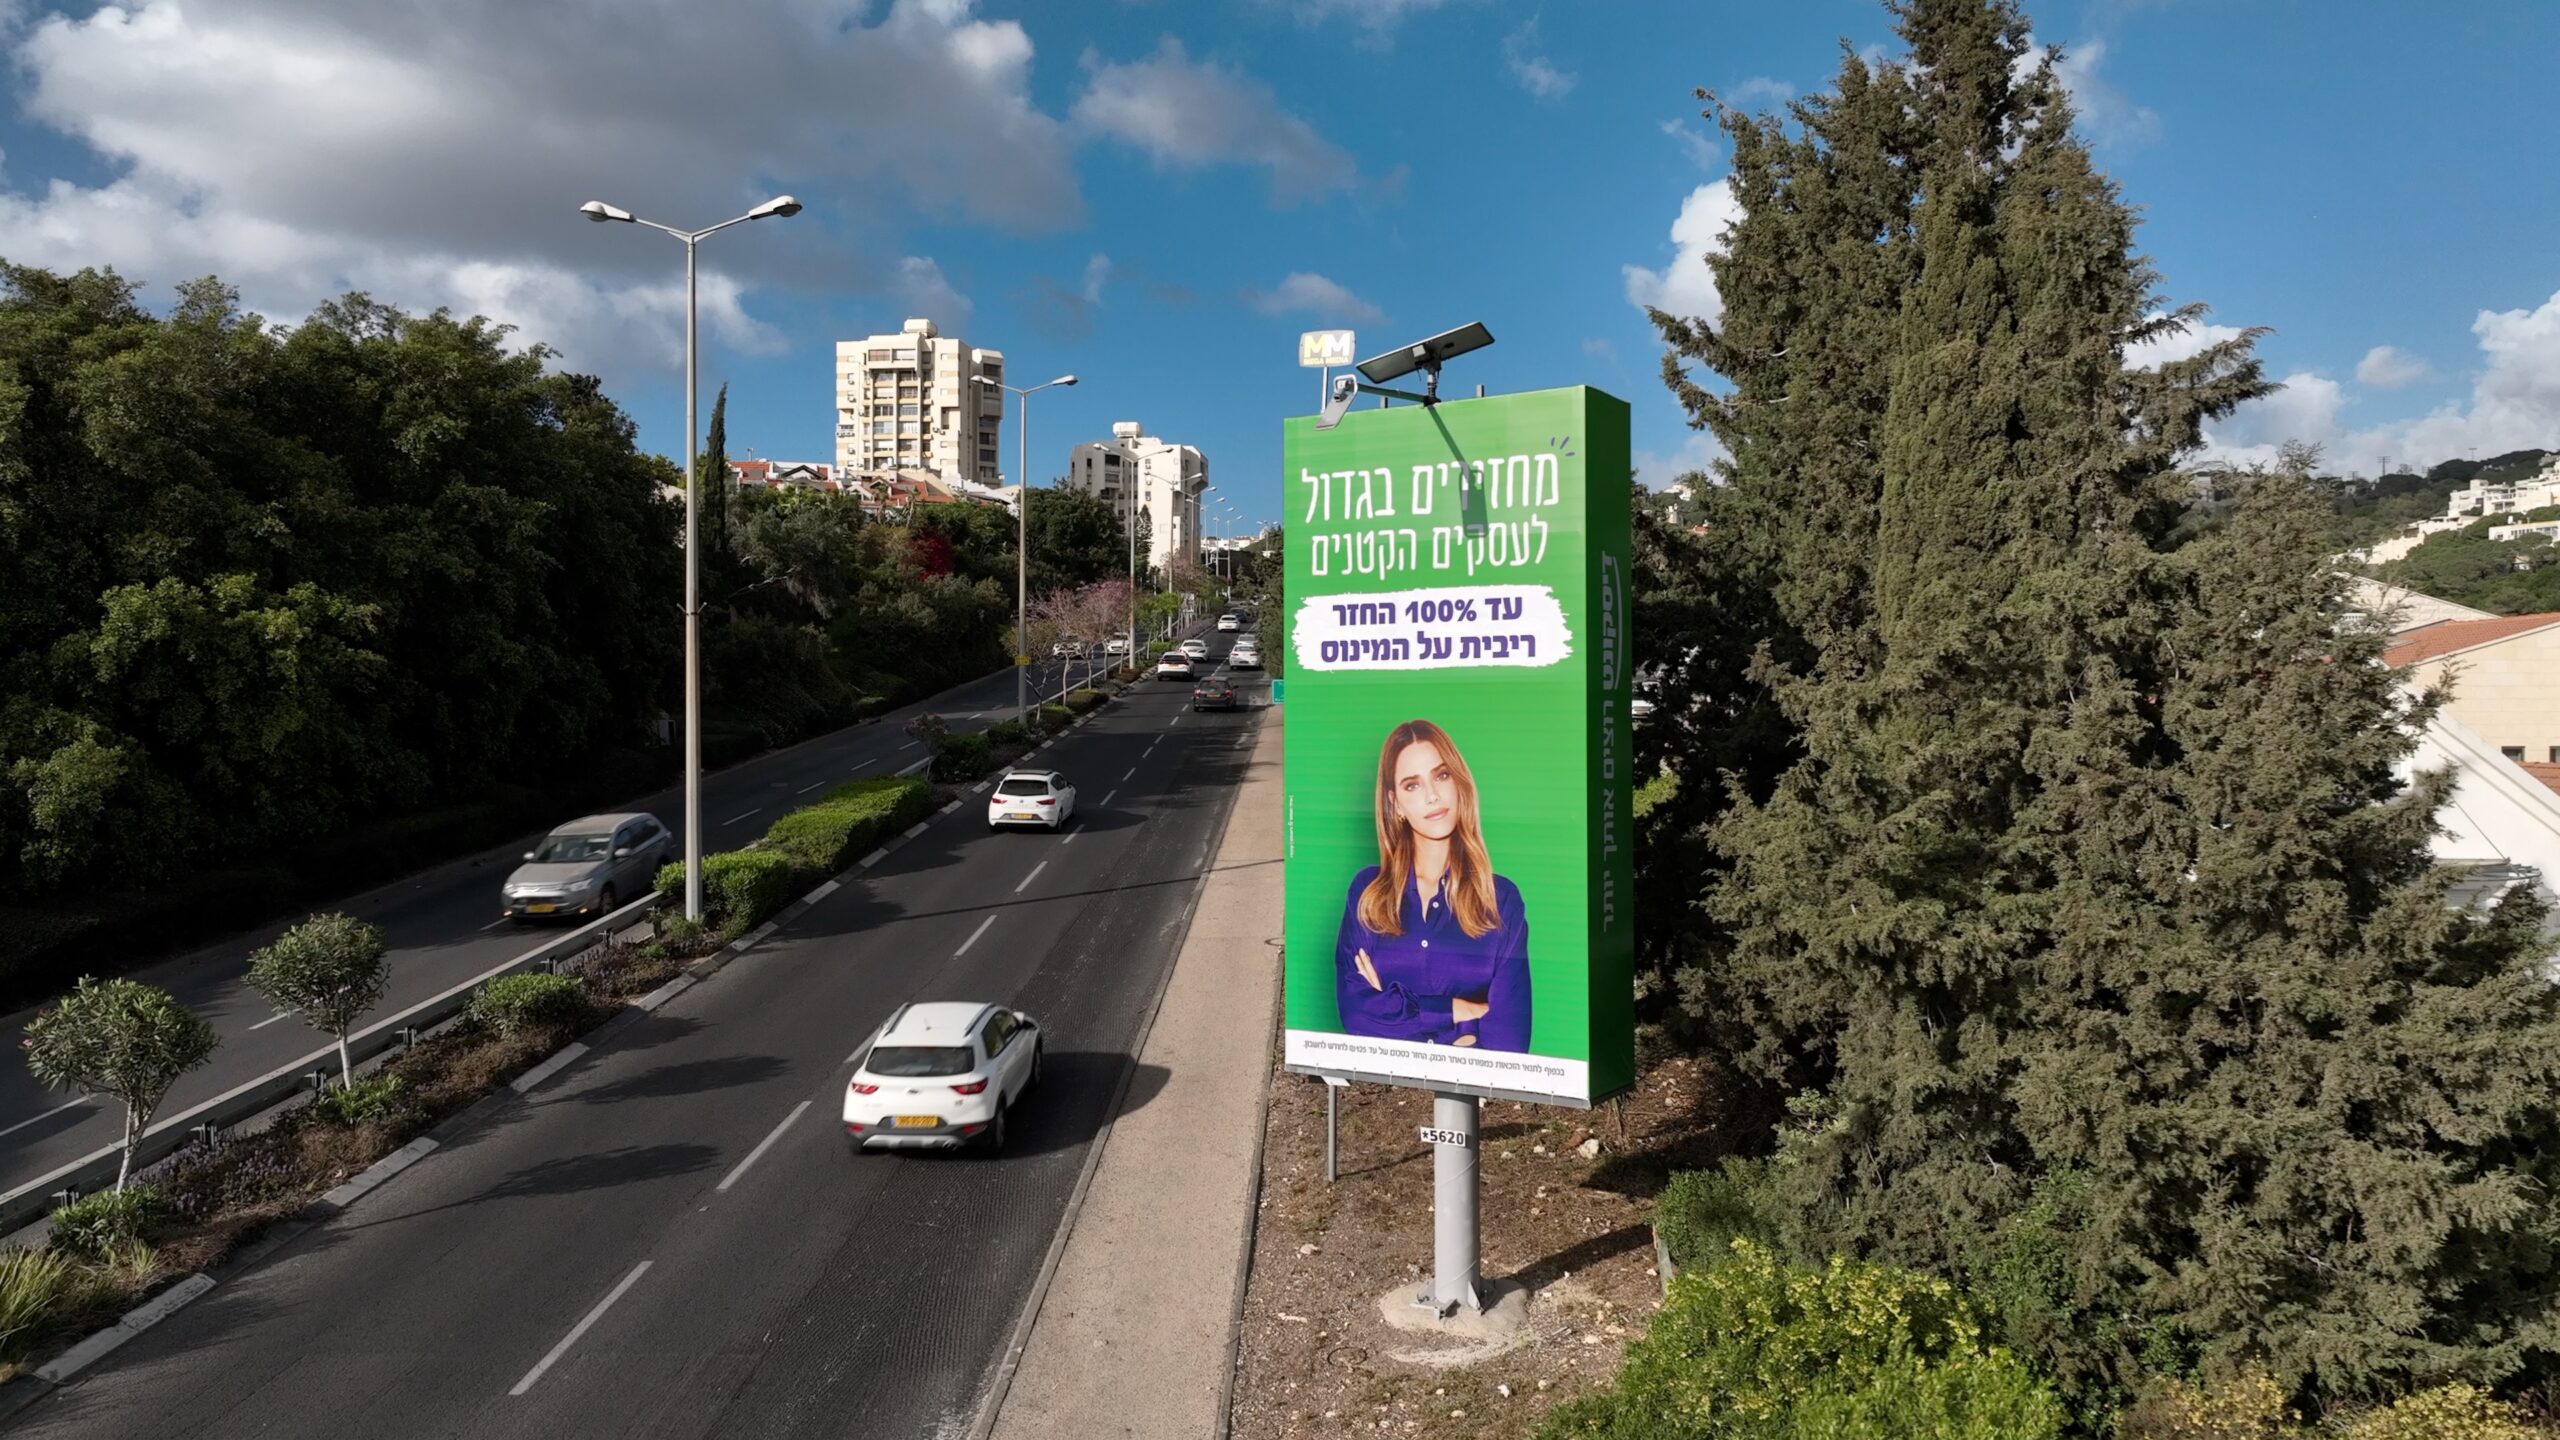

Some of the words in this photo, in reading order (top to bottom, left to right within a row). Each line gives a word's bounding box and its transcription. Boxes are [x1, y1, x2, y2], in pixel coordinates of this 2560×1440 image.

[1301, 466, 1396, 524] בגדול
[1410, 453, 1560, 518] מחזירים
[1311, 528, 1418, 580] הקטנים
[1431, 513, 1548, 577] לעסקים
[1333, 601, 1396, 626] החזר
[1406, 598, 1477, 624] 100%
[1486, 597, 1523, 621] עד
[1602, 550, 1618, 691] דיסקונט
[1321, 636, 1409, 663] המינוס
[1418, 631, 1452, 660] על
[1460, 634, 1536, 660] ריבית
[1602, 699, 1615, 780] רוצים
[1602, 788, 1618, 862] אותך
[1602, 870, 1615, 932] יותר
